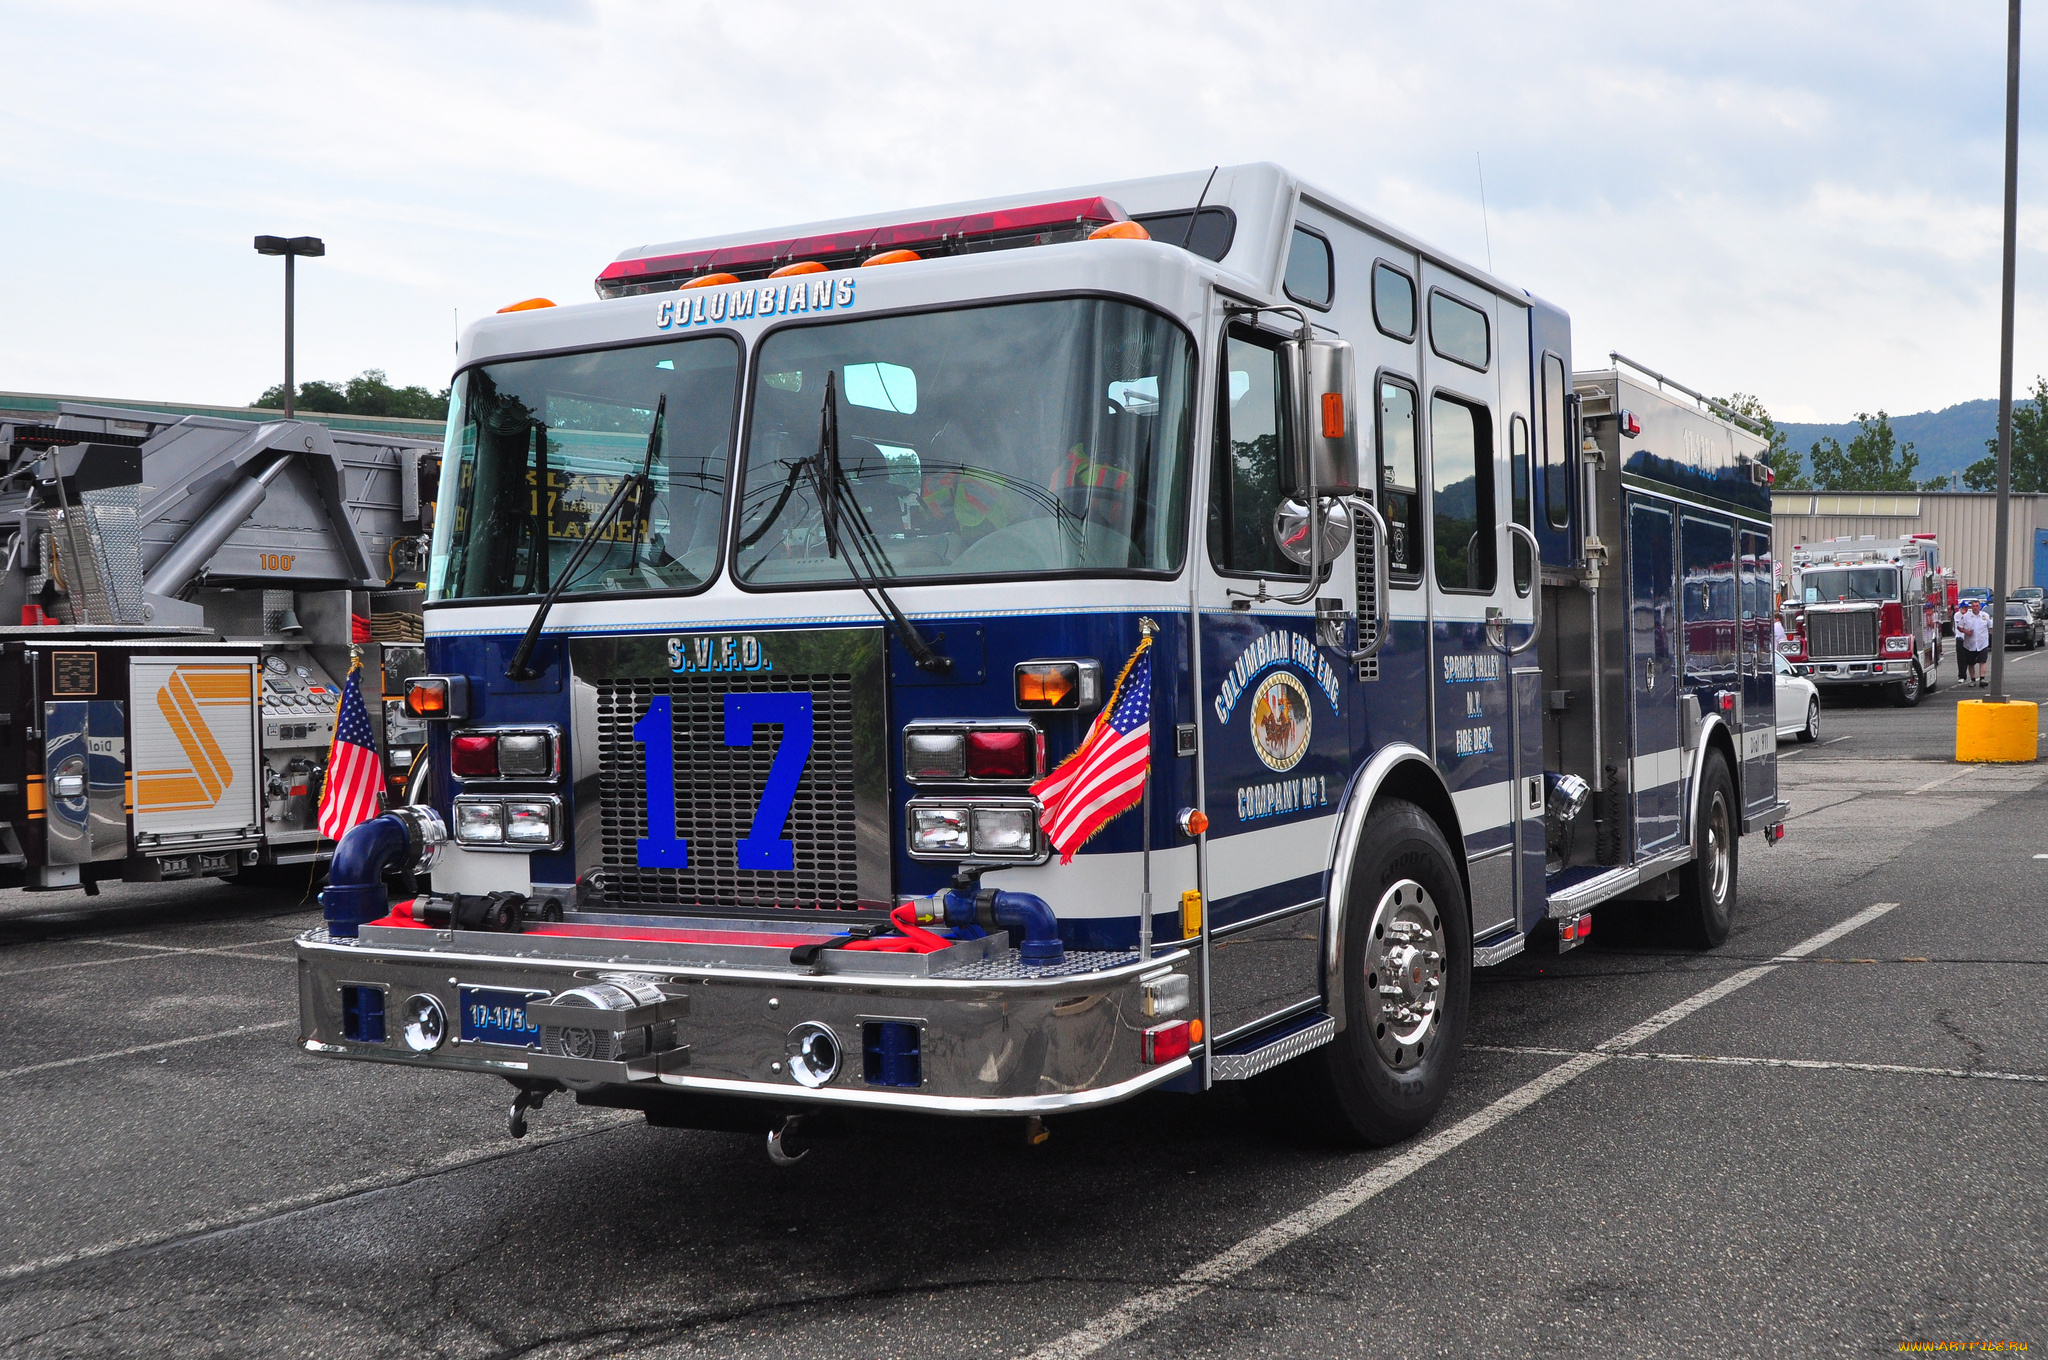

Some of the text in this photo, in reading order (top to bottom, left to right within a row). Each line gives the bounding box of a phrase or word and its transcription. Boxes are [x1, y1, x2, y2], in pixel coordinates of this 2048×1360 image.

[656, 276, 856, 330] COLUMBIANS
[667, 635, 772, 673] S.V.F.D.
[1443, 655, 1500, 683] SPRING VALLEY
[1214, 629, 1290, 725] COLUMBIAN
[1291, 631, 1318, 678] FIRE
[1456, 729, 1473, 757] FIRE
[1750, 732, 1769, 754] Dial 911
[633, 692, 813, 870] 17
[1237, 779, 1300, 821] COMPANY
[1319, 775, 1328, 805] 1
